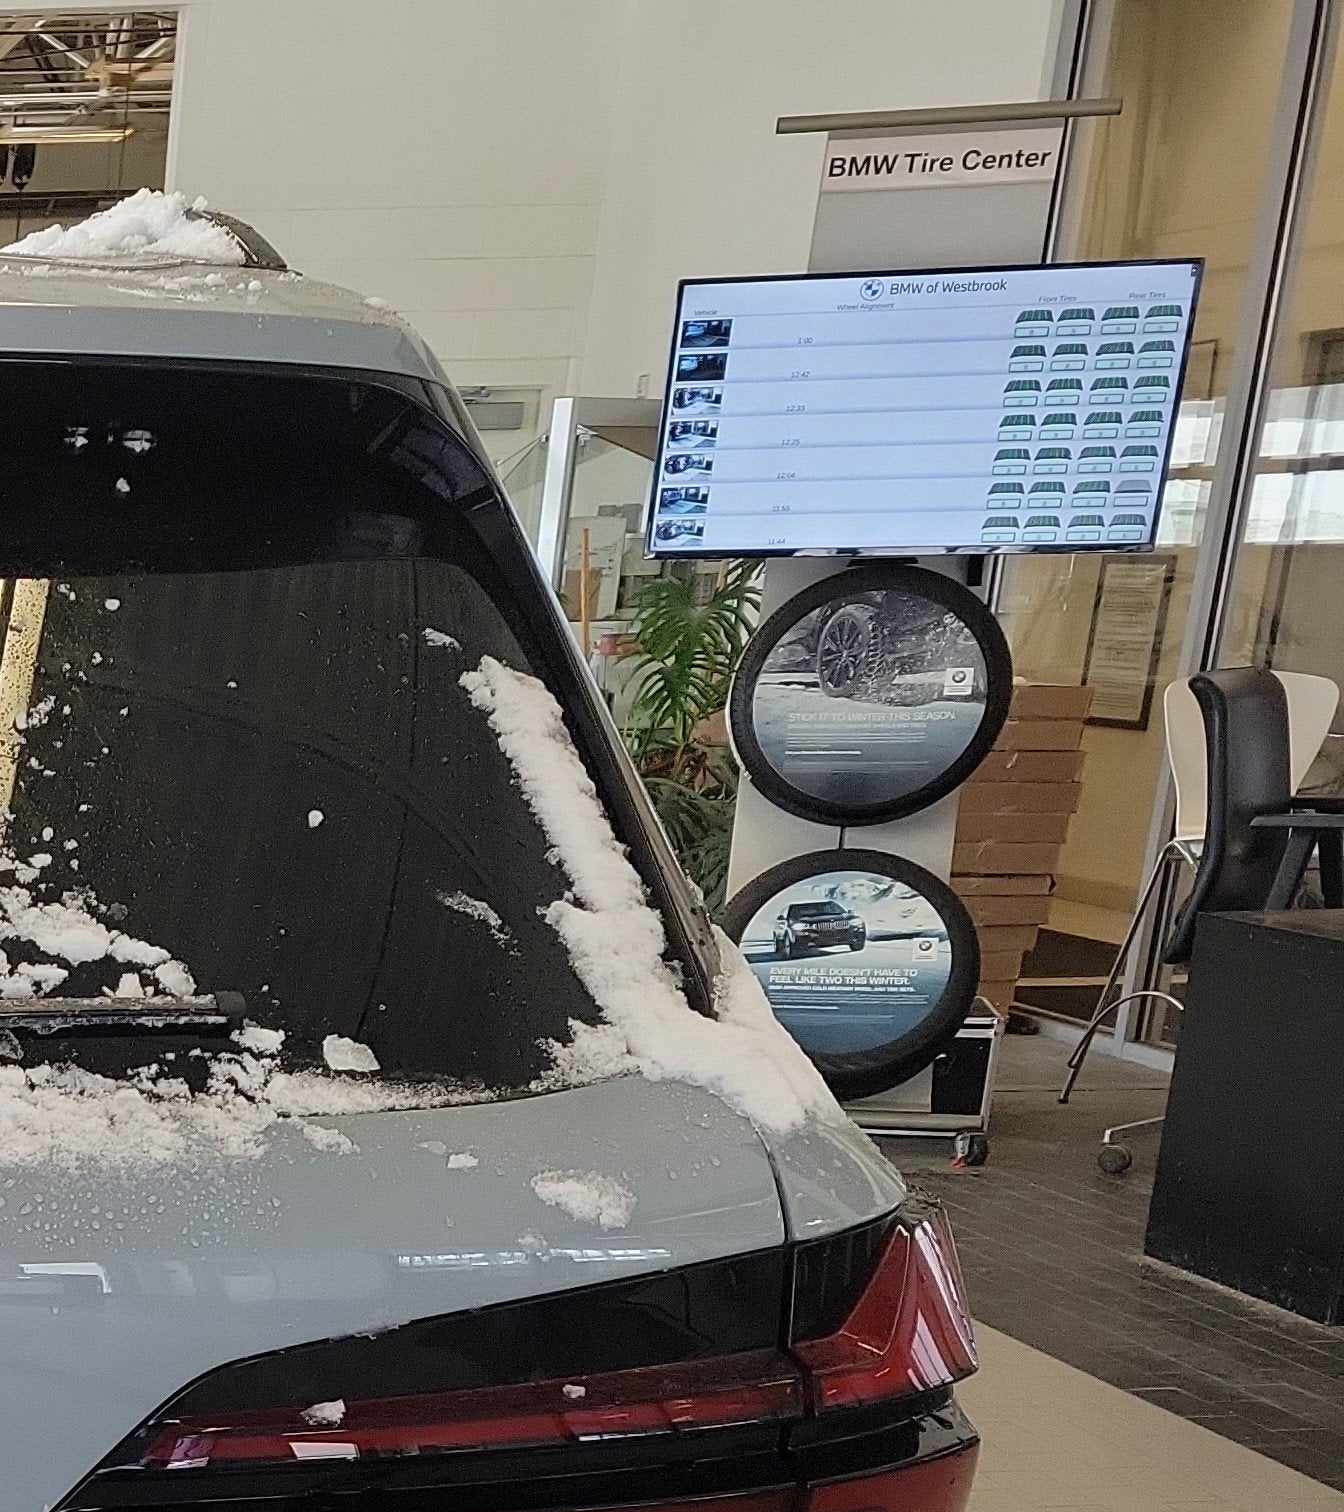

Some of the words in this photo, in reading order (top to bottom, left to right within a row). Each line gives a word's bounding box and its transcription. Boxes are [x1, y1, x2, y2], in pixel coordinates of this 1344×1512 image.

[828, 154, 899, 178] BMW
[904, 152, 953, 174] Tire
[961, 149, 1052, 171] Center
[890, 282, 923, 295] BMW
[926, 281, 940, 293] of
[942, 279, 1007, 293] Westbrook
[770, 967, 803, 975] EVERY
[804, 967, 827, 975] MILE
[829, 968, 871, 976] DOESN'T
[874, 968, 903, 976] HAVE
[905, 969, 918, 977] TO
[770, 975, 794, 983] FEEL
[795, 975, 817, 983] LIKE
[820, 976, 842, 984] TWO
[845, 976, 867, 984] THIS
[869, 977, 910, 985] WINTER.
